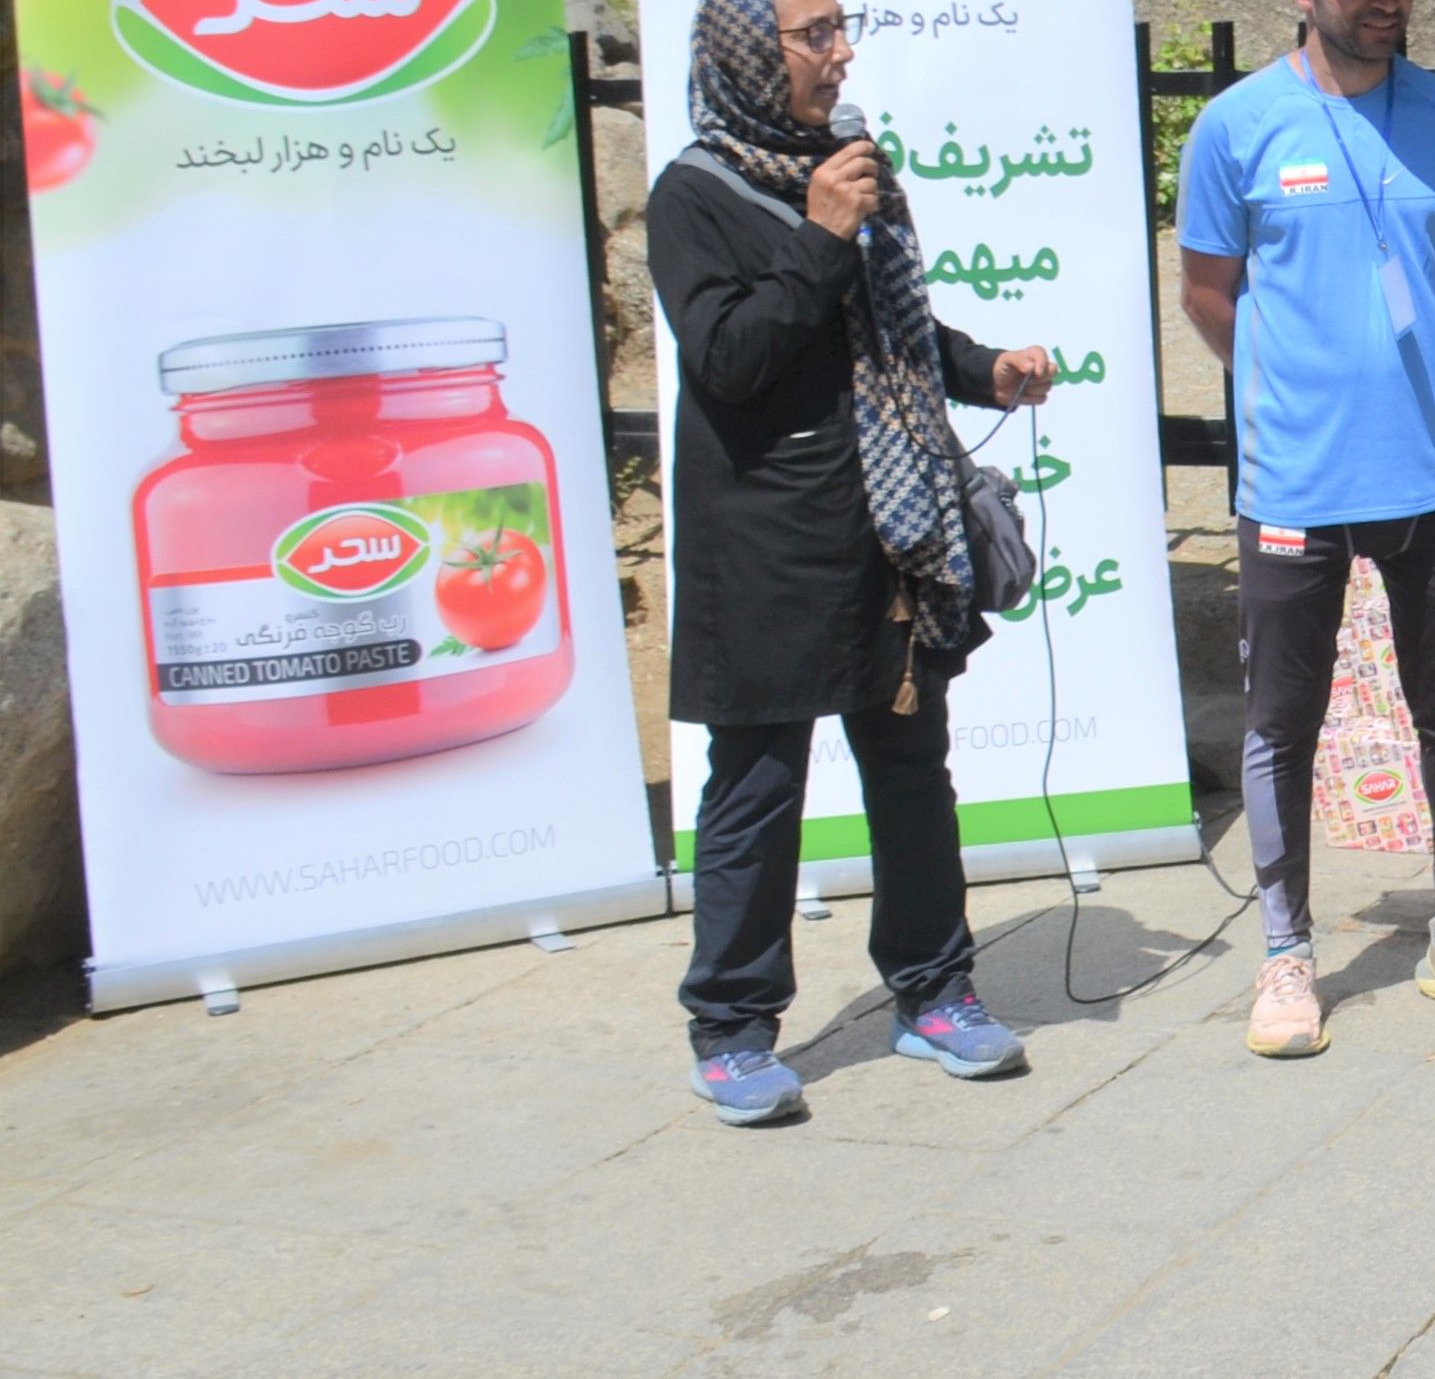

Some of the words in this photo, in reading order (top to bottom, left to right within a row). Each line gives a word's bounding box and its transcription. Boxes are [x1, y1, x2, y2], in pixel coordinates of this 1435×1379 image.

[862, 1, 905, 38] هزا
[910, 10, 926, 37] و
[932, 1, 971, 39] نام
[977, 1, 1020, 34] یک
[175, 136, 264, 174] لبخند
[270, 134, 329, 172] هزار
[338, 142, 355, 169] و
[362, 129, 404, 171] نام
[411, 127, 457, 162] یک
[307, 534, 402, 574] سحر
[235, 624, 307, 650] فرنگی
[313, 610, 378, 645] گوجه
[169, 661, 251, 689] CANNED
[255, 652, 341, 680] TOMATO
[345, 643, 411, 671] PASTE
[194, 823, 557, 909] WWW.SAHARFOOD.COM
